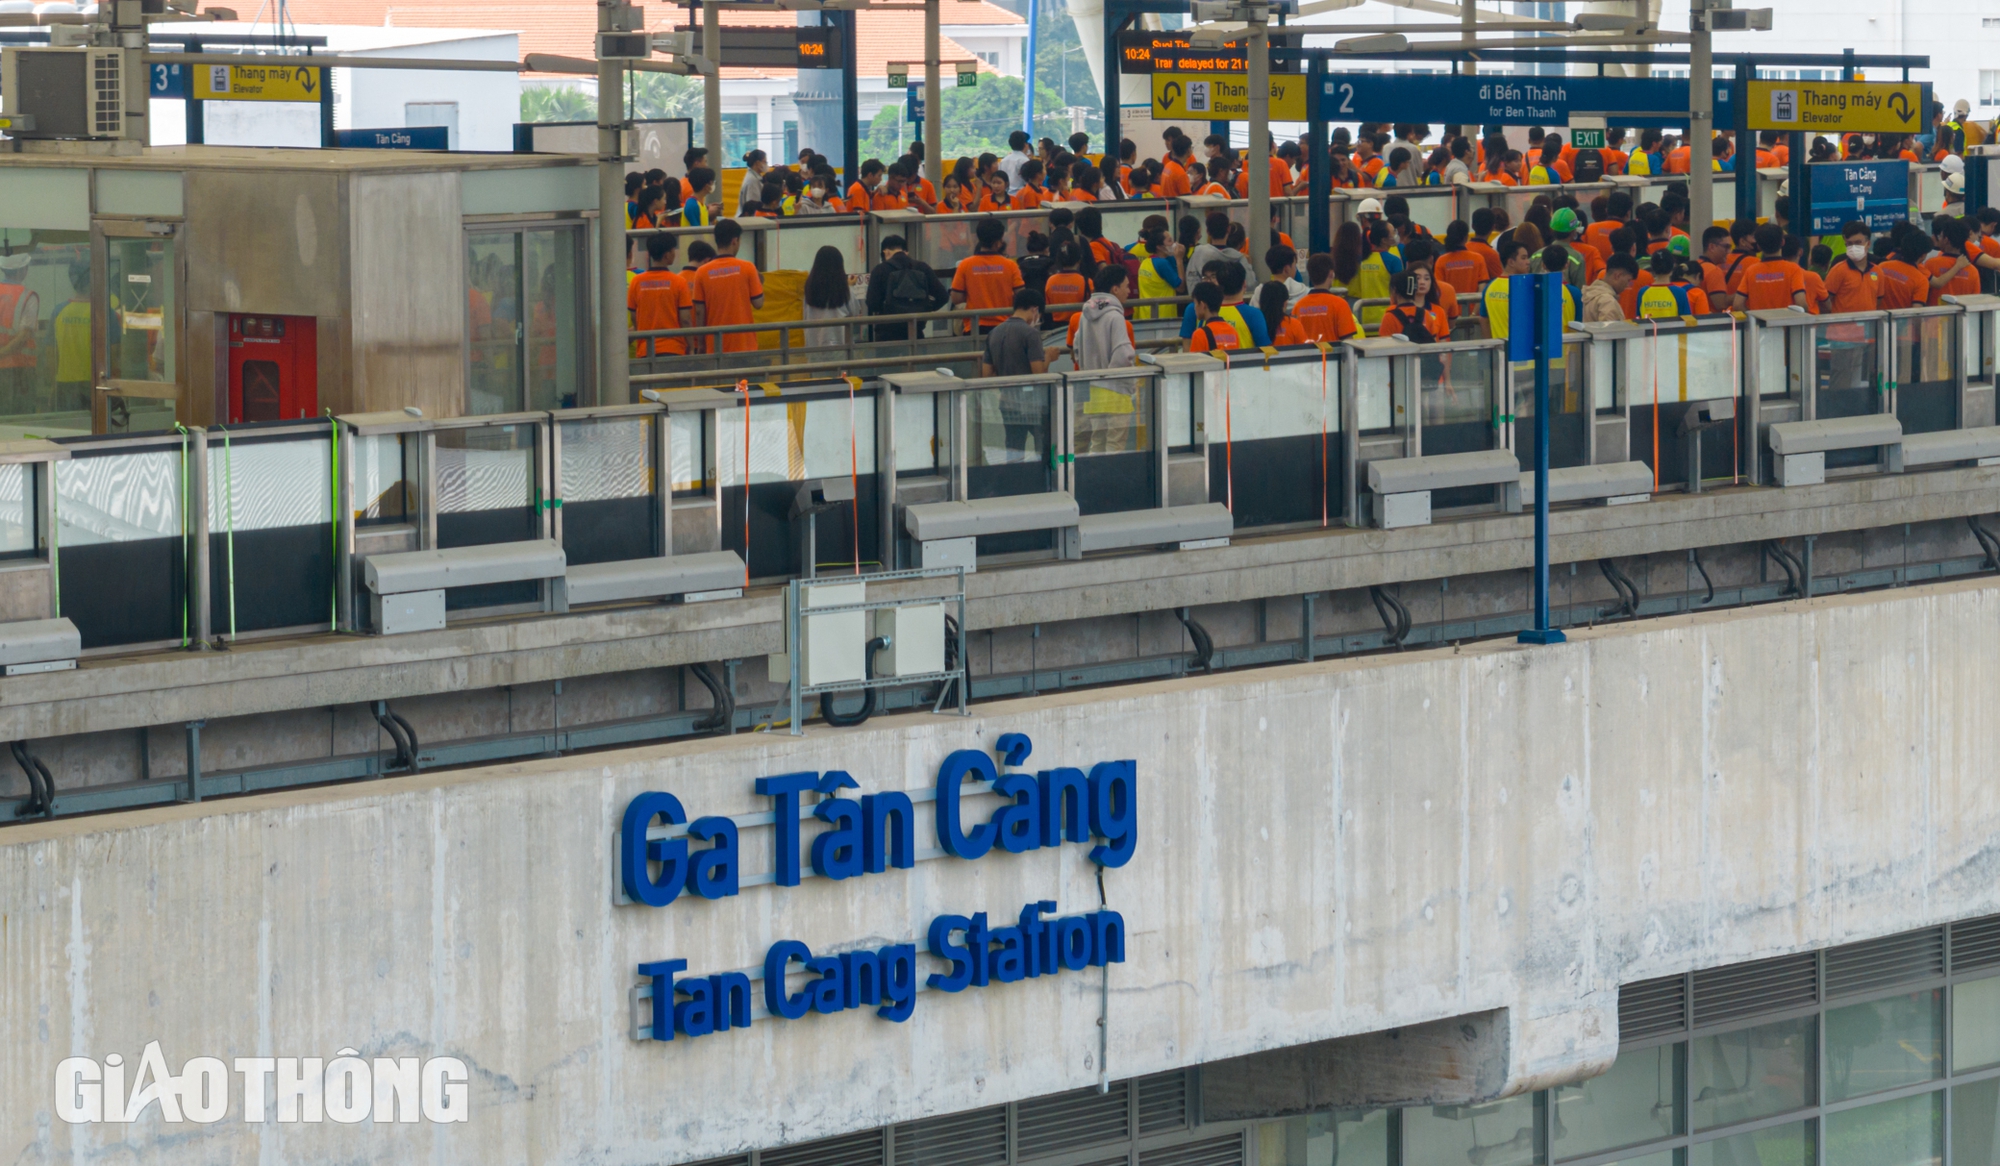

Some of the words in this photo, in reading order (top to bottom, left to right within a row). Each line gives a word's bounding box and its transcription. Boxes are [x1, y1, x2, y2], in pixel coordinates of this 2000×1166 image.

[799, 43, 824, 56] 10:24
[1125, 48, 1150, 60] 10:24
[1178, 58, 1214, 70] delayed
[1215, 58, 1229, 69] for
[1231, 58, 1242, 69] 21
[156, 64, 169, 91] 3
[233, 65, 266, 82] Thang
[269, 65, 292, 83] máy
[958, 73, 972, 85] EXIT
[233, 83, 264, 94] Elevator
[1479, 85, 1491, 100] đi
[1494, 83, 1521, 100] Bến
[1524, 84, 1567, 101] Thành
[1339, 83, 1354, 113] 2
[1803, 90, 1847, 110] Thang
[1851, 90, 1882, 110] máy
[1489, 106, 1503, 117] for
[1505, 106, 1525, 118] Ben
[1527, 106, 1557, 118] Thanh
[1802, 111, 1843, 123] Elevator
[375, 133, 390, 144] Tân
[391, 131, 411, 146] Cảng
[1576, 131, 1600, 146] EXIT
[1844, 168, 1858, 181] Tân
[1859, 166, 1877, 183] Cảng
[1644, 300, 1672, 308] HUTECH
[621, 790, 739, 907] Ga
[755, 770, 914, 887] Tân
[935, 732, 1137, 868] Cảng
[638, 957, 752, 1041] Tan
[764, 940, 917, 1023] Cang
[926, 900, 1126, 993] Station
